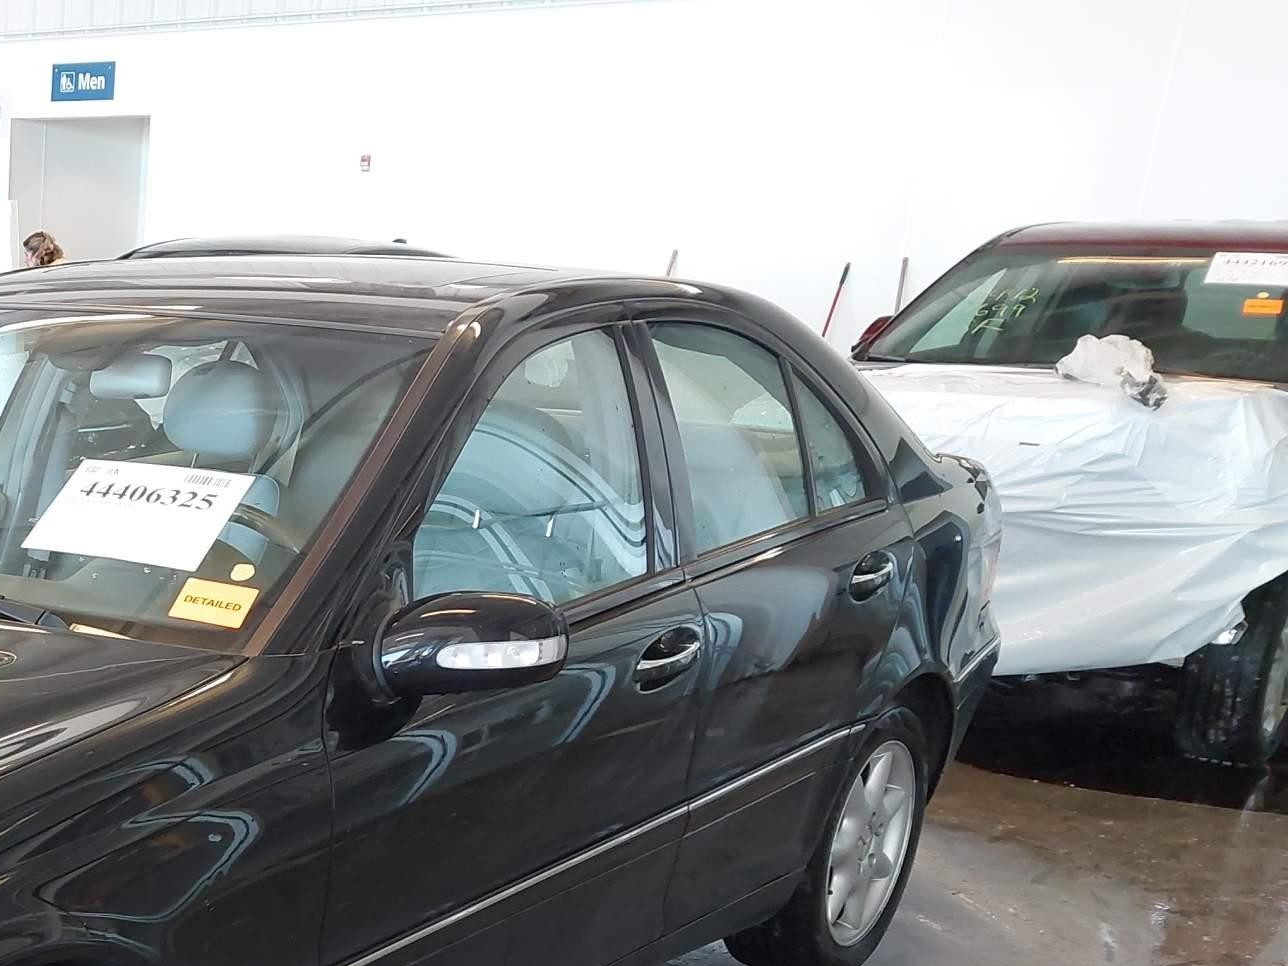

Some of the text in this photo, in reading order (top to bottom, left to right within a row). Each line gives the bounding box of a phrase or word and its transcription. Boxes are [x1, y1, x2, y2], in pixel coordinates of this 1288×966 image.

[78, 72, 105, 90] Men
[80, 481, 219, 510] 44406325
[183, 594, 242, 612] DETAILED
